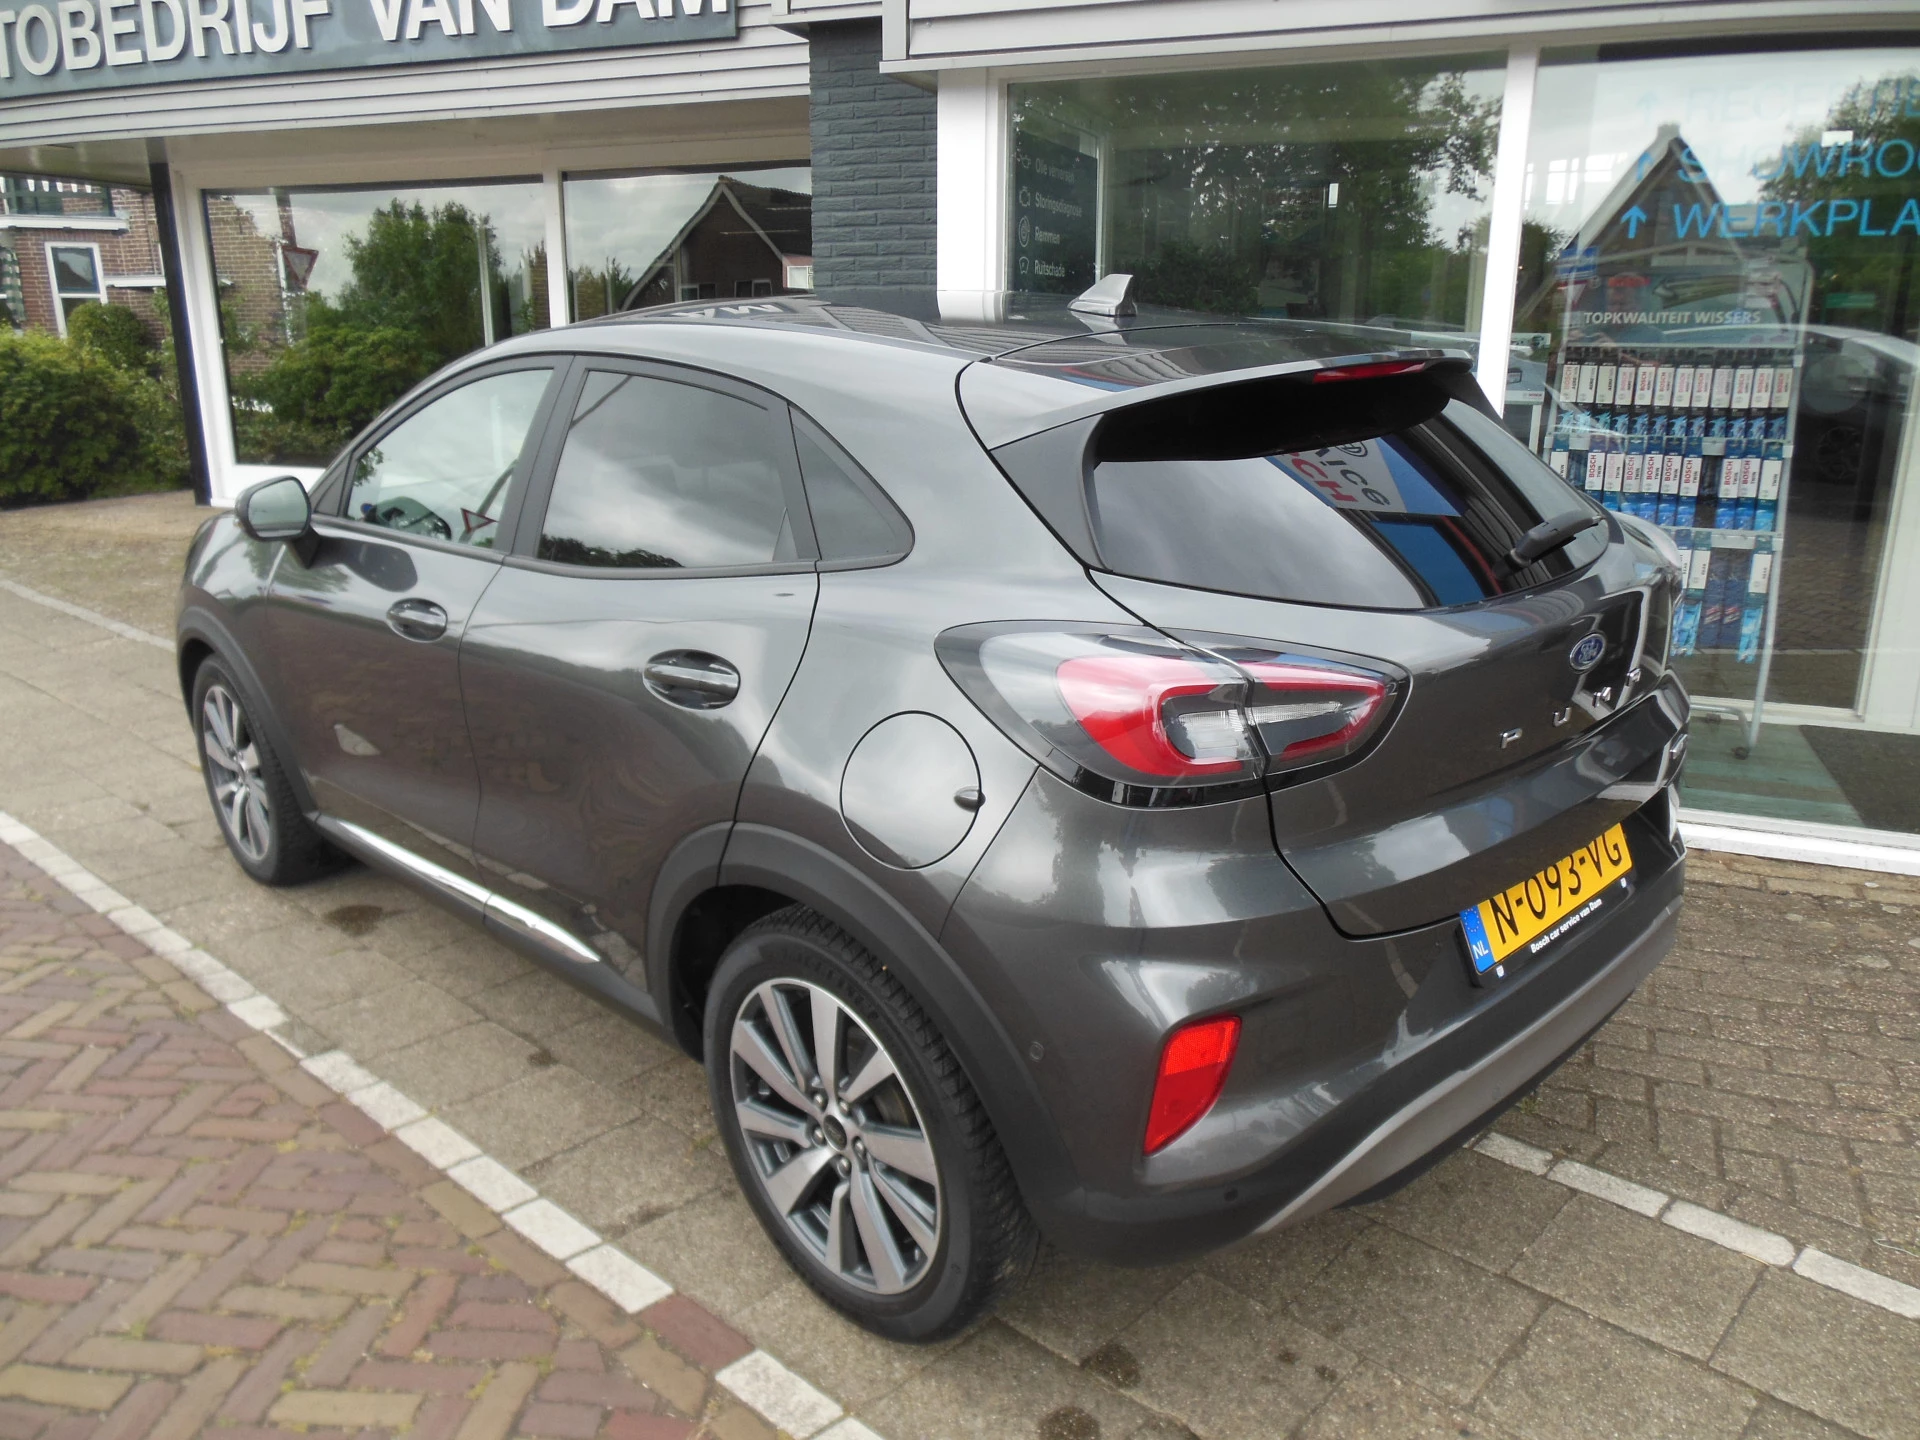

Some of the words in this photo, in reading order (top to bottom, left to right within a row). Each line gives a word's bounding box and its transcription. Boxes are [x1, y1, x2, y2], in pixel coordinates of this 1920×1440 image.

[1677, 139, 1920, 182] SHOWRO
[1584, 311, 1690, 325] TOPKWALITEIT
[1694, 310, 1761, 324] WISSERS
[1588, 454, 1596, 478] BOSCH
[1626, 456, 1634, 480] BOSCH
[1646, 456, 1654, 480] BOSCH
[1664, 458, 1673, 482] BOSCH
[1684, 460, 1692, 484] BOSCH
[1724, 460, 1734, 486] BOSCH
[1742, 460, 1751, 484] BOSCH
[1488, 833, 1622, 945] N-093-VG
[1530, 935, 1551, 954] Bosch
[1550, 928, 1560, 940] car
[1560, 914, 1580, 933] service
[1579, 906, 1591, 918] van
[1588, 898, 1603, 911] Dam
[1472, 940, 1489, 960] NL
